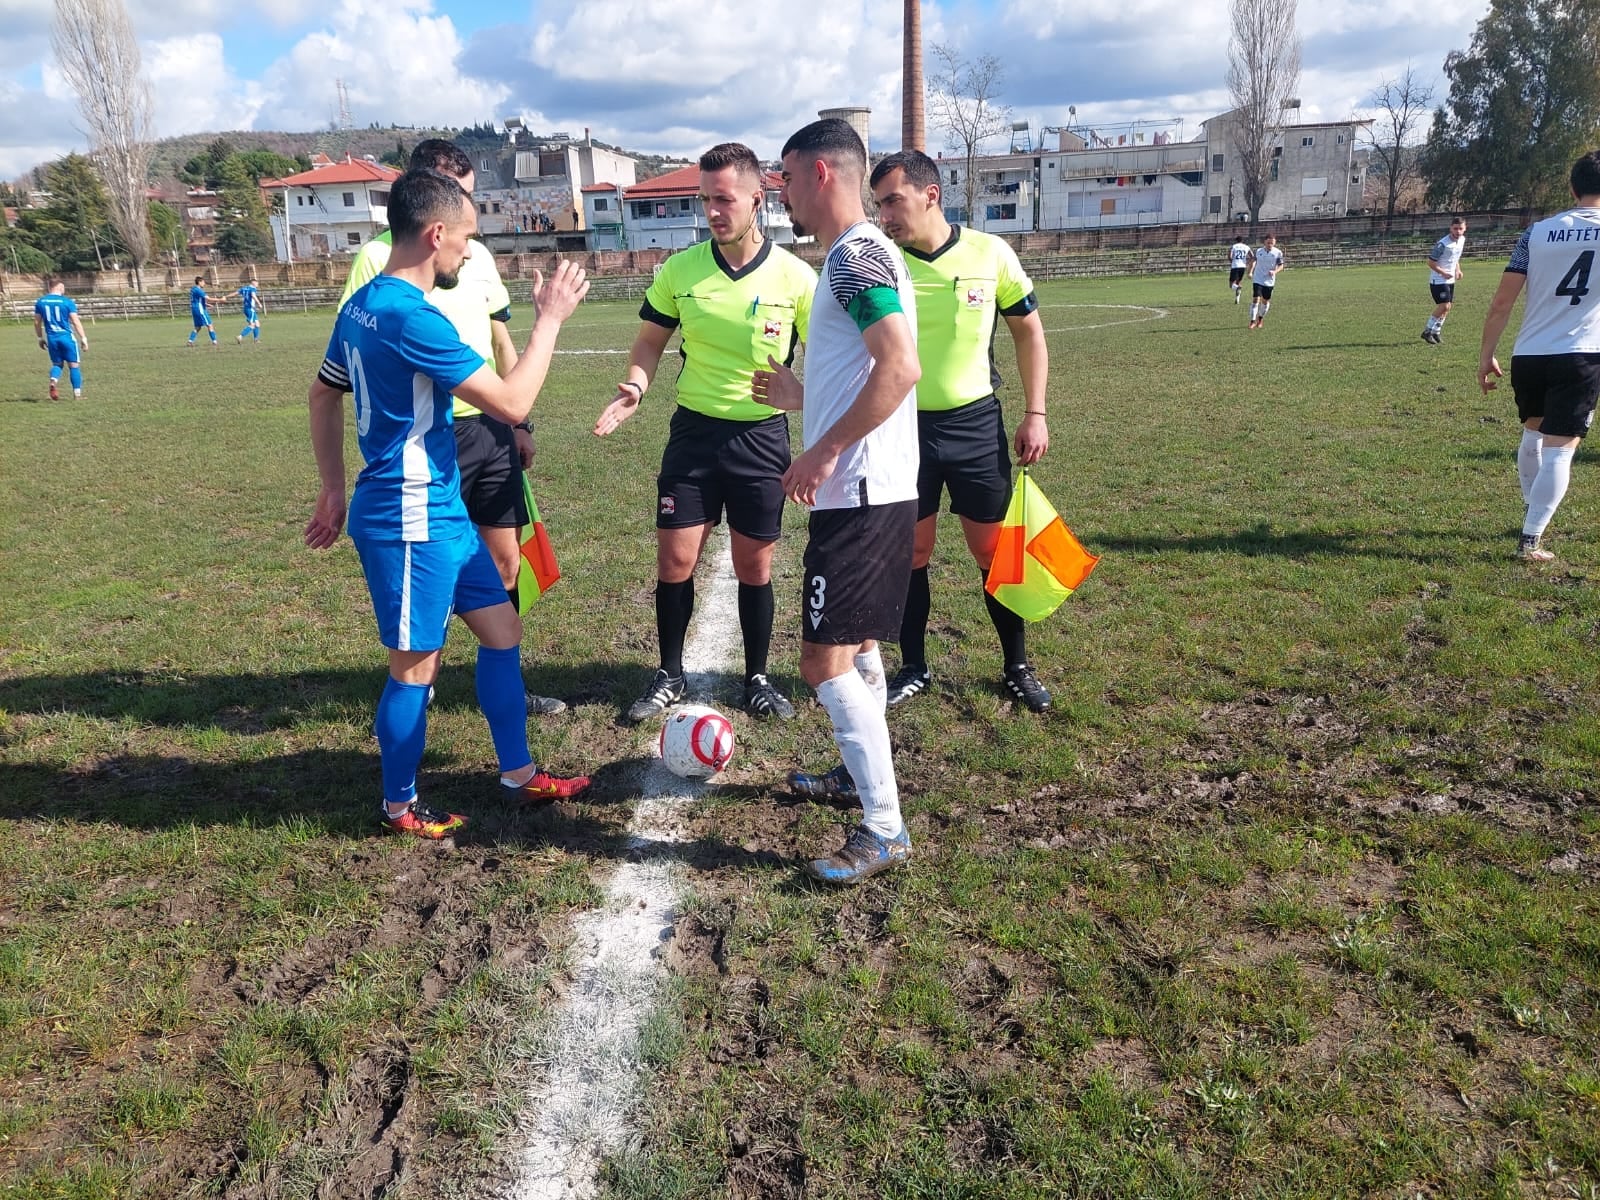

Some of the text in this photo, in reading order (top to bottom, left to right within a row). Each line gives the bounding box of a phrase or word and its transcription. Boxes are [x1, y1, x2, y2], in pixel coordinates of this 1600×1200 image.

[1555, 250, 1595, 305] 4
[45, 305, 61, 322] 11
[810, 575, 827, 610] 3
